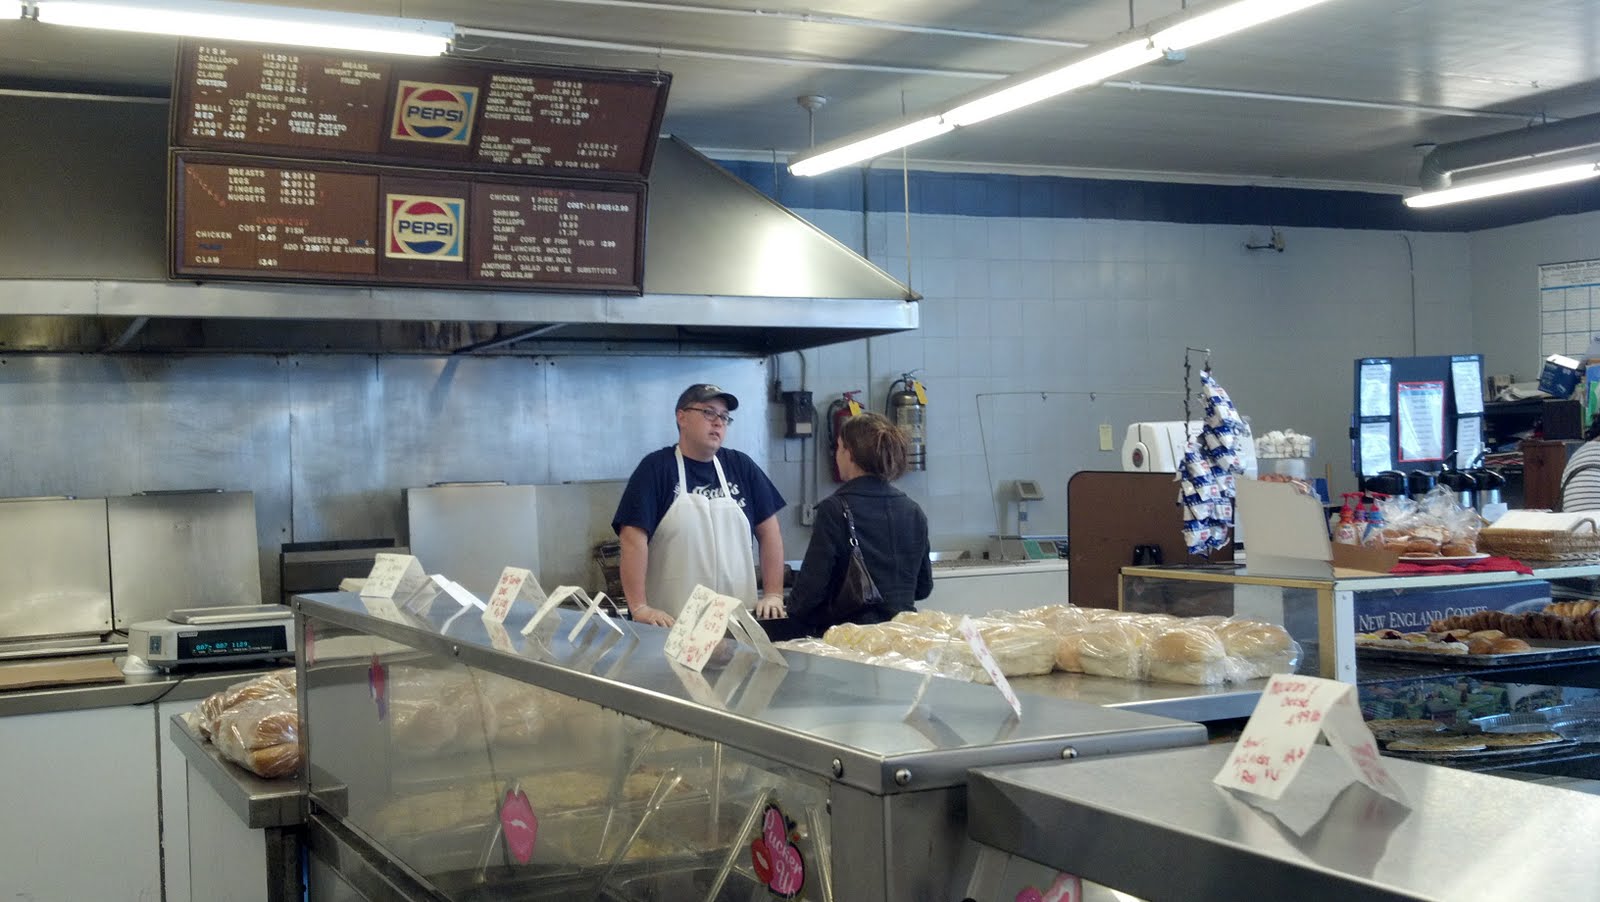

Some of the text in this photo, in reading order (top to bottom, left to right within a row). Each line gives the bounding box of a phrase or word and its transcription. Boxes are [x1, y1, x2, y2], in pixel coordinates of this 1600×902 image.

[199, 54, 238, 65] SCALLOPS
[197, 62, 227, 71] SHRIMP
[197, 70, 224, 79] CLAMS
[492, 75, 533, 85] MUSHROOMS
[490, 82, 535, 92] CAULIFLOWER
[246, 92, 279, 101] FRENCH
[228, 98, 250, 107] COST
[194, 103, 223, 113] SMALL
[486, 104, 530, 114] MOZZARELLA
[540, 109, 564, 117] STICKS
[194, 111, 214, 120] MED
[291, 111, 314, 120] OKRA
[407, 105, 464, 122] PEPSI
[193, 120, 222, 130] LARGE
[288, 119, 316, 128] SWEET
[480, 142, 514, 151] CALAMARI
[479, 149, 510, 158] CHICKEN
[512, 157, 522, 165] OR
[228, 167, 265, 177] BREASTS
[304, 172, 316, 181] LB
[228, 176, 250, 185] LEGS
[304, 180, 316, 189] LB
[228, 185, 265, 194] FINGERS
[304, 189, 316, 198] LB
[228, 193, 266, 203] NUGGETS
[304, 198, 315, 206] LB
[489, 193, 520, 202] CHICKEN
[537, 197, 559, 205] PIECE
[537, 204, 559, 212] PIECE
[493, 209, 520, 218] SHRIMP
[493, 217, 525, 226] SCALLOPS
[238, 224, 305, 235] COST OF FISH
[398, 220, 453, 236] PEPSI
[492, 225, 516, 233] CLAMS
[195, 230, 232, 240] CHICKEN
[302, 235, 333, 245] CHEESE
[334, 237, 349, 246] ADD
[520, 236, 536, 244] COST
[578, 239, 595, 247] PLUS
[283, 242, 299, 251] ADD
[332, 246, 342, 254] BE
[345, 246, 376, 256] LUNCHES
[510, 245, 541, 253] LUNCHES
[545, 247, 572, 255] INCLUDE
[195, 255, 220, 264] CLAM
[481, 262, 512, 270] ANOTHER
[520, 264, 541, 272] SALAD
[545, 265, 560, 273] CAN
[577, 266, 618, 275] SUBSTITUTED
[480, 270, 534, 279] FOR COLESLAW
